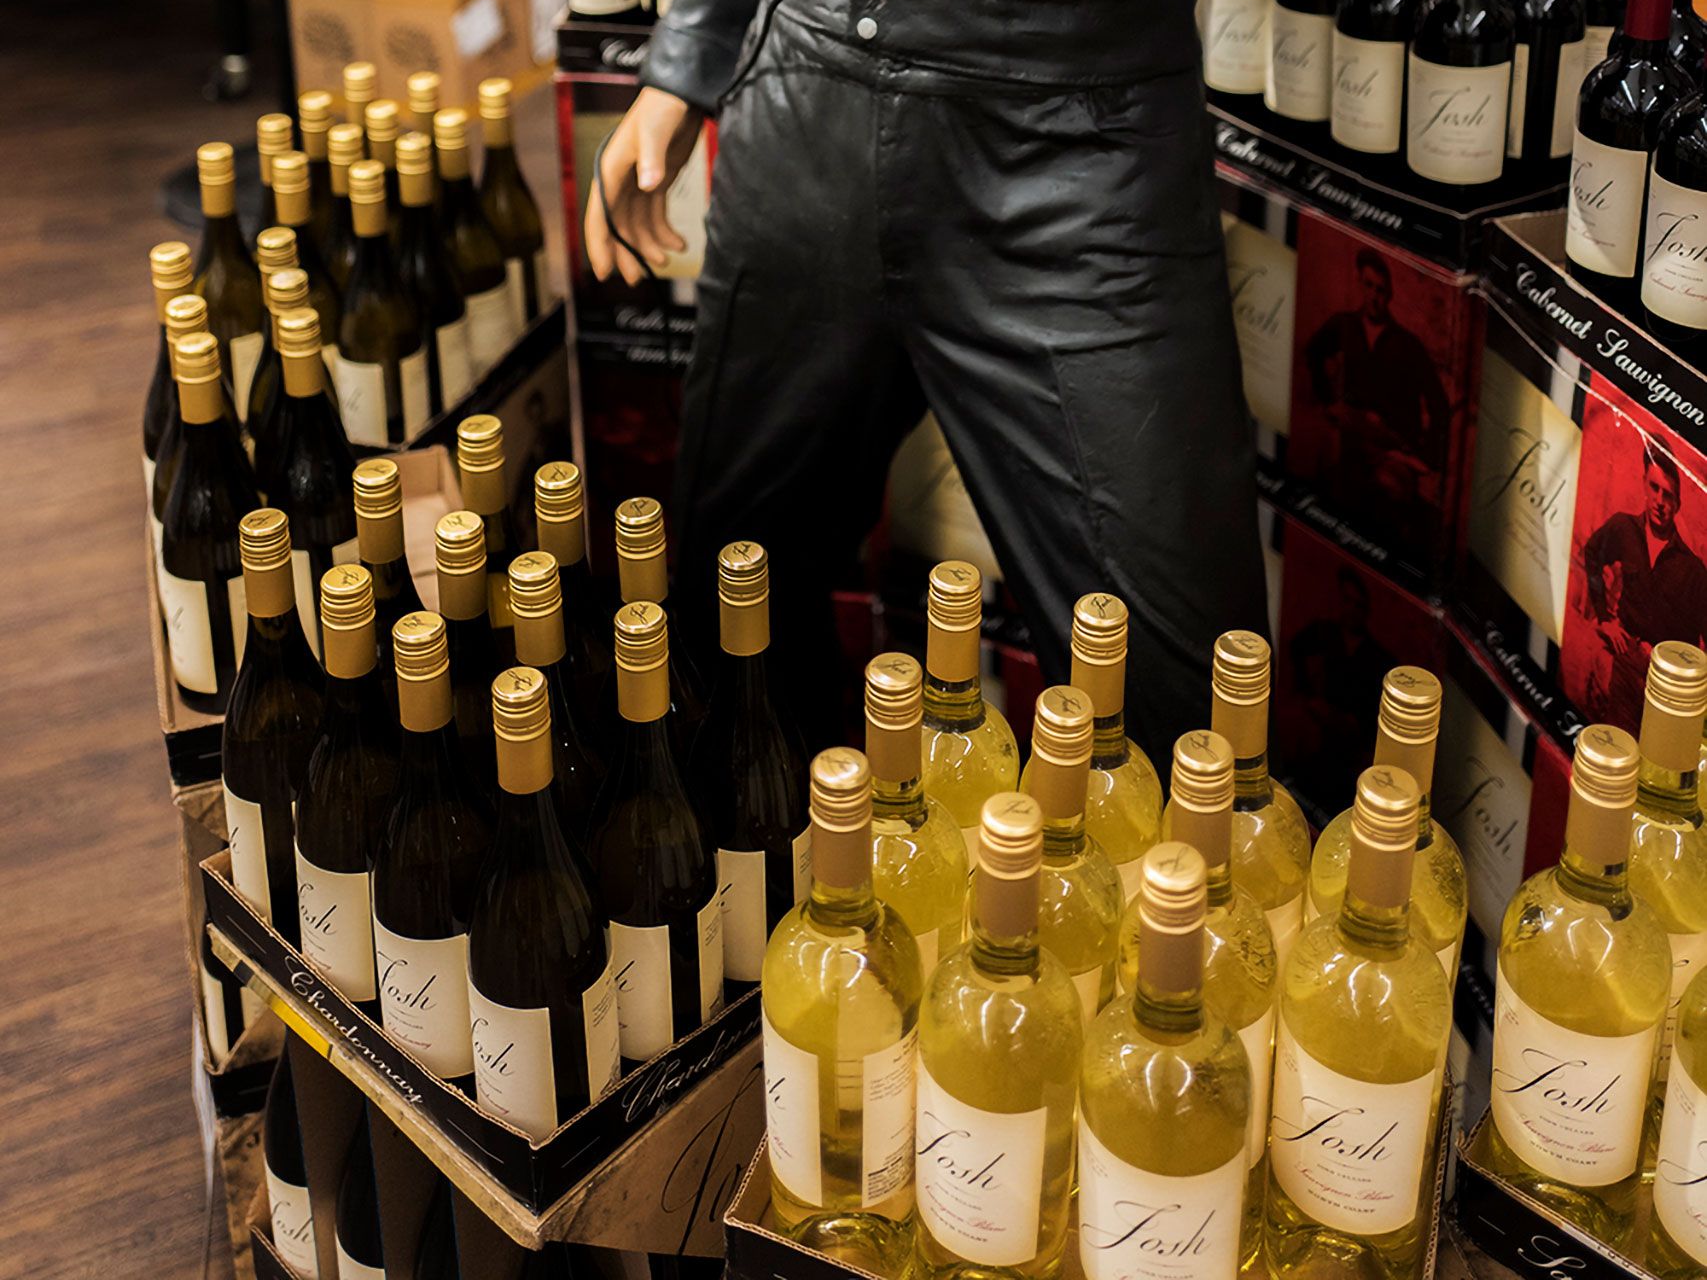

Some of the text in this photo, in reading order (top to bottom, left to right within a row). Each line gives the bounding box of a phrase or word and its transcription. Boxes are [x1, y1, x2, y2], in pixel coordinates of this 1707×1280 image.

[1414, 85, 1491, 140] Josh
[1516, 262, 1705, 426] Cabernet Sauvignon
[378, 950, 437, 1011] Josh
[284, 954, 424, 1105] Chardonnay
[1493, 1047, 1621, 1115] Josh
[916, 1111, 1005, 1191] Josh
[1272, 1095, 1398, 1161] Josh
[1081, 1200, 1216, 1257] Josh
